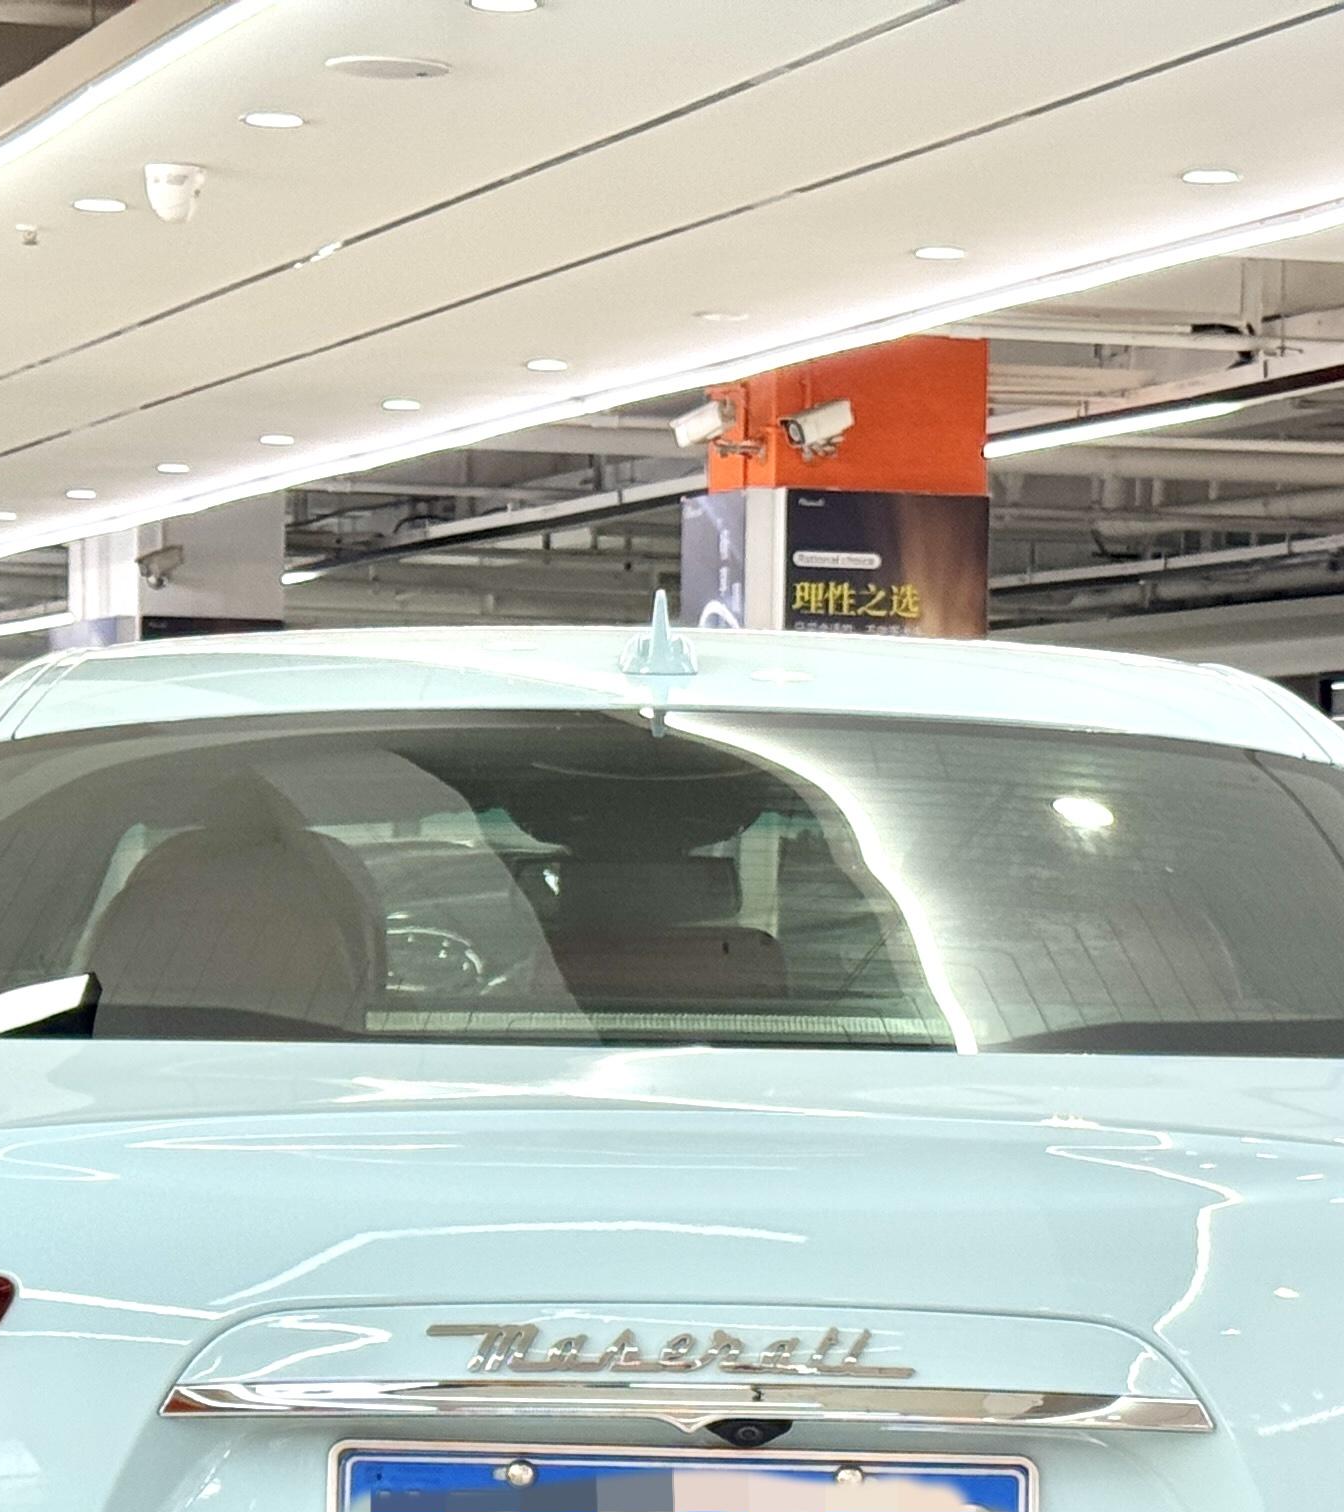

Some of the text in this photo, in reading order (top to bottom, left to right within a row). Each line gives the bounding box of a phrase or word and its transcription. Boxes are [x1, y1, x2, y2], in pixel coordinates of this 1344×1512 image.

[792, 581, 920, 618] 理性之选
[425, 1323, 918, 1379] Maserati
